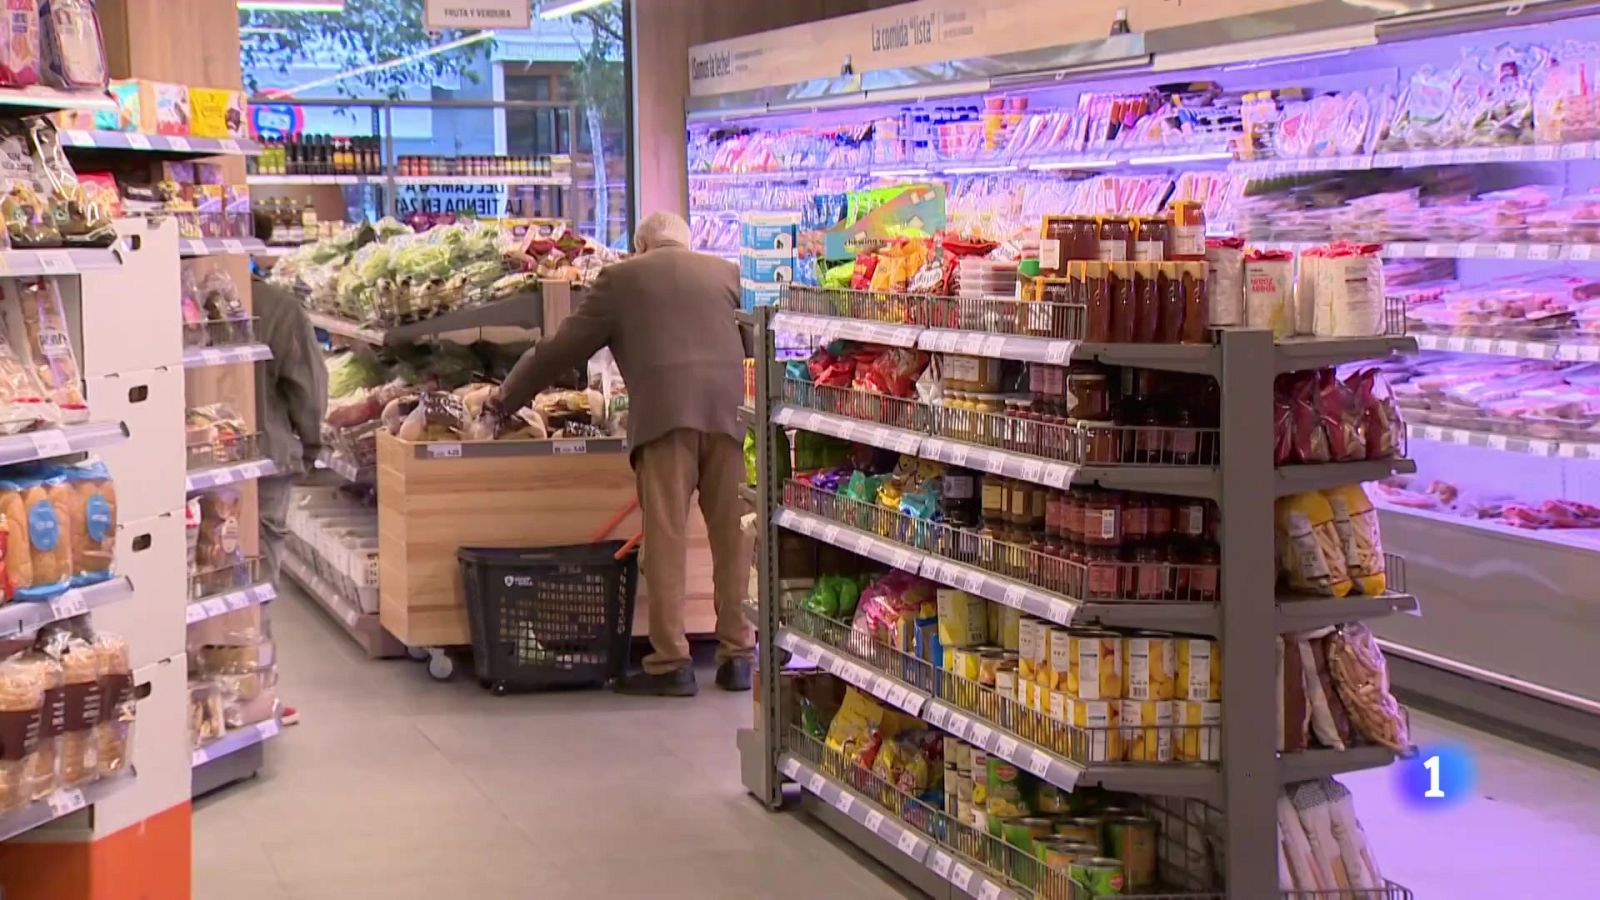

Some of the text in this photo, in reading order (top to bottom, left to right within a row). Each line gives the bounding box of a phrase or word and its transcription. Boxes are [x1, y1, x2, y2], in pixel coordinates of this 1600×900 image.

[444, 8, 511, 18] FRUTA Y VERDURA
[872, 23, 881, 51] La
[882, 18, 908, 51] comida
